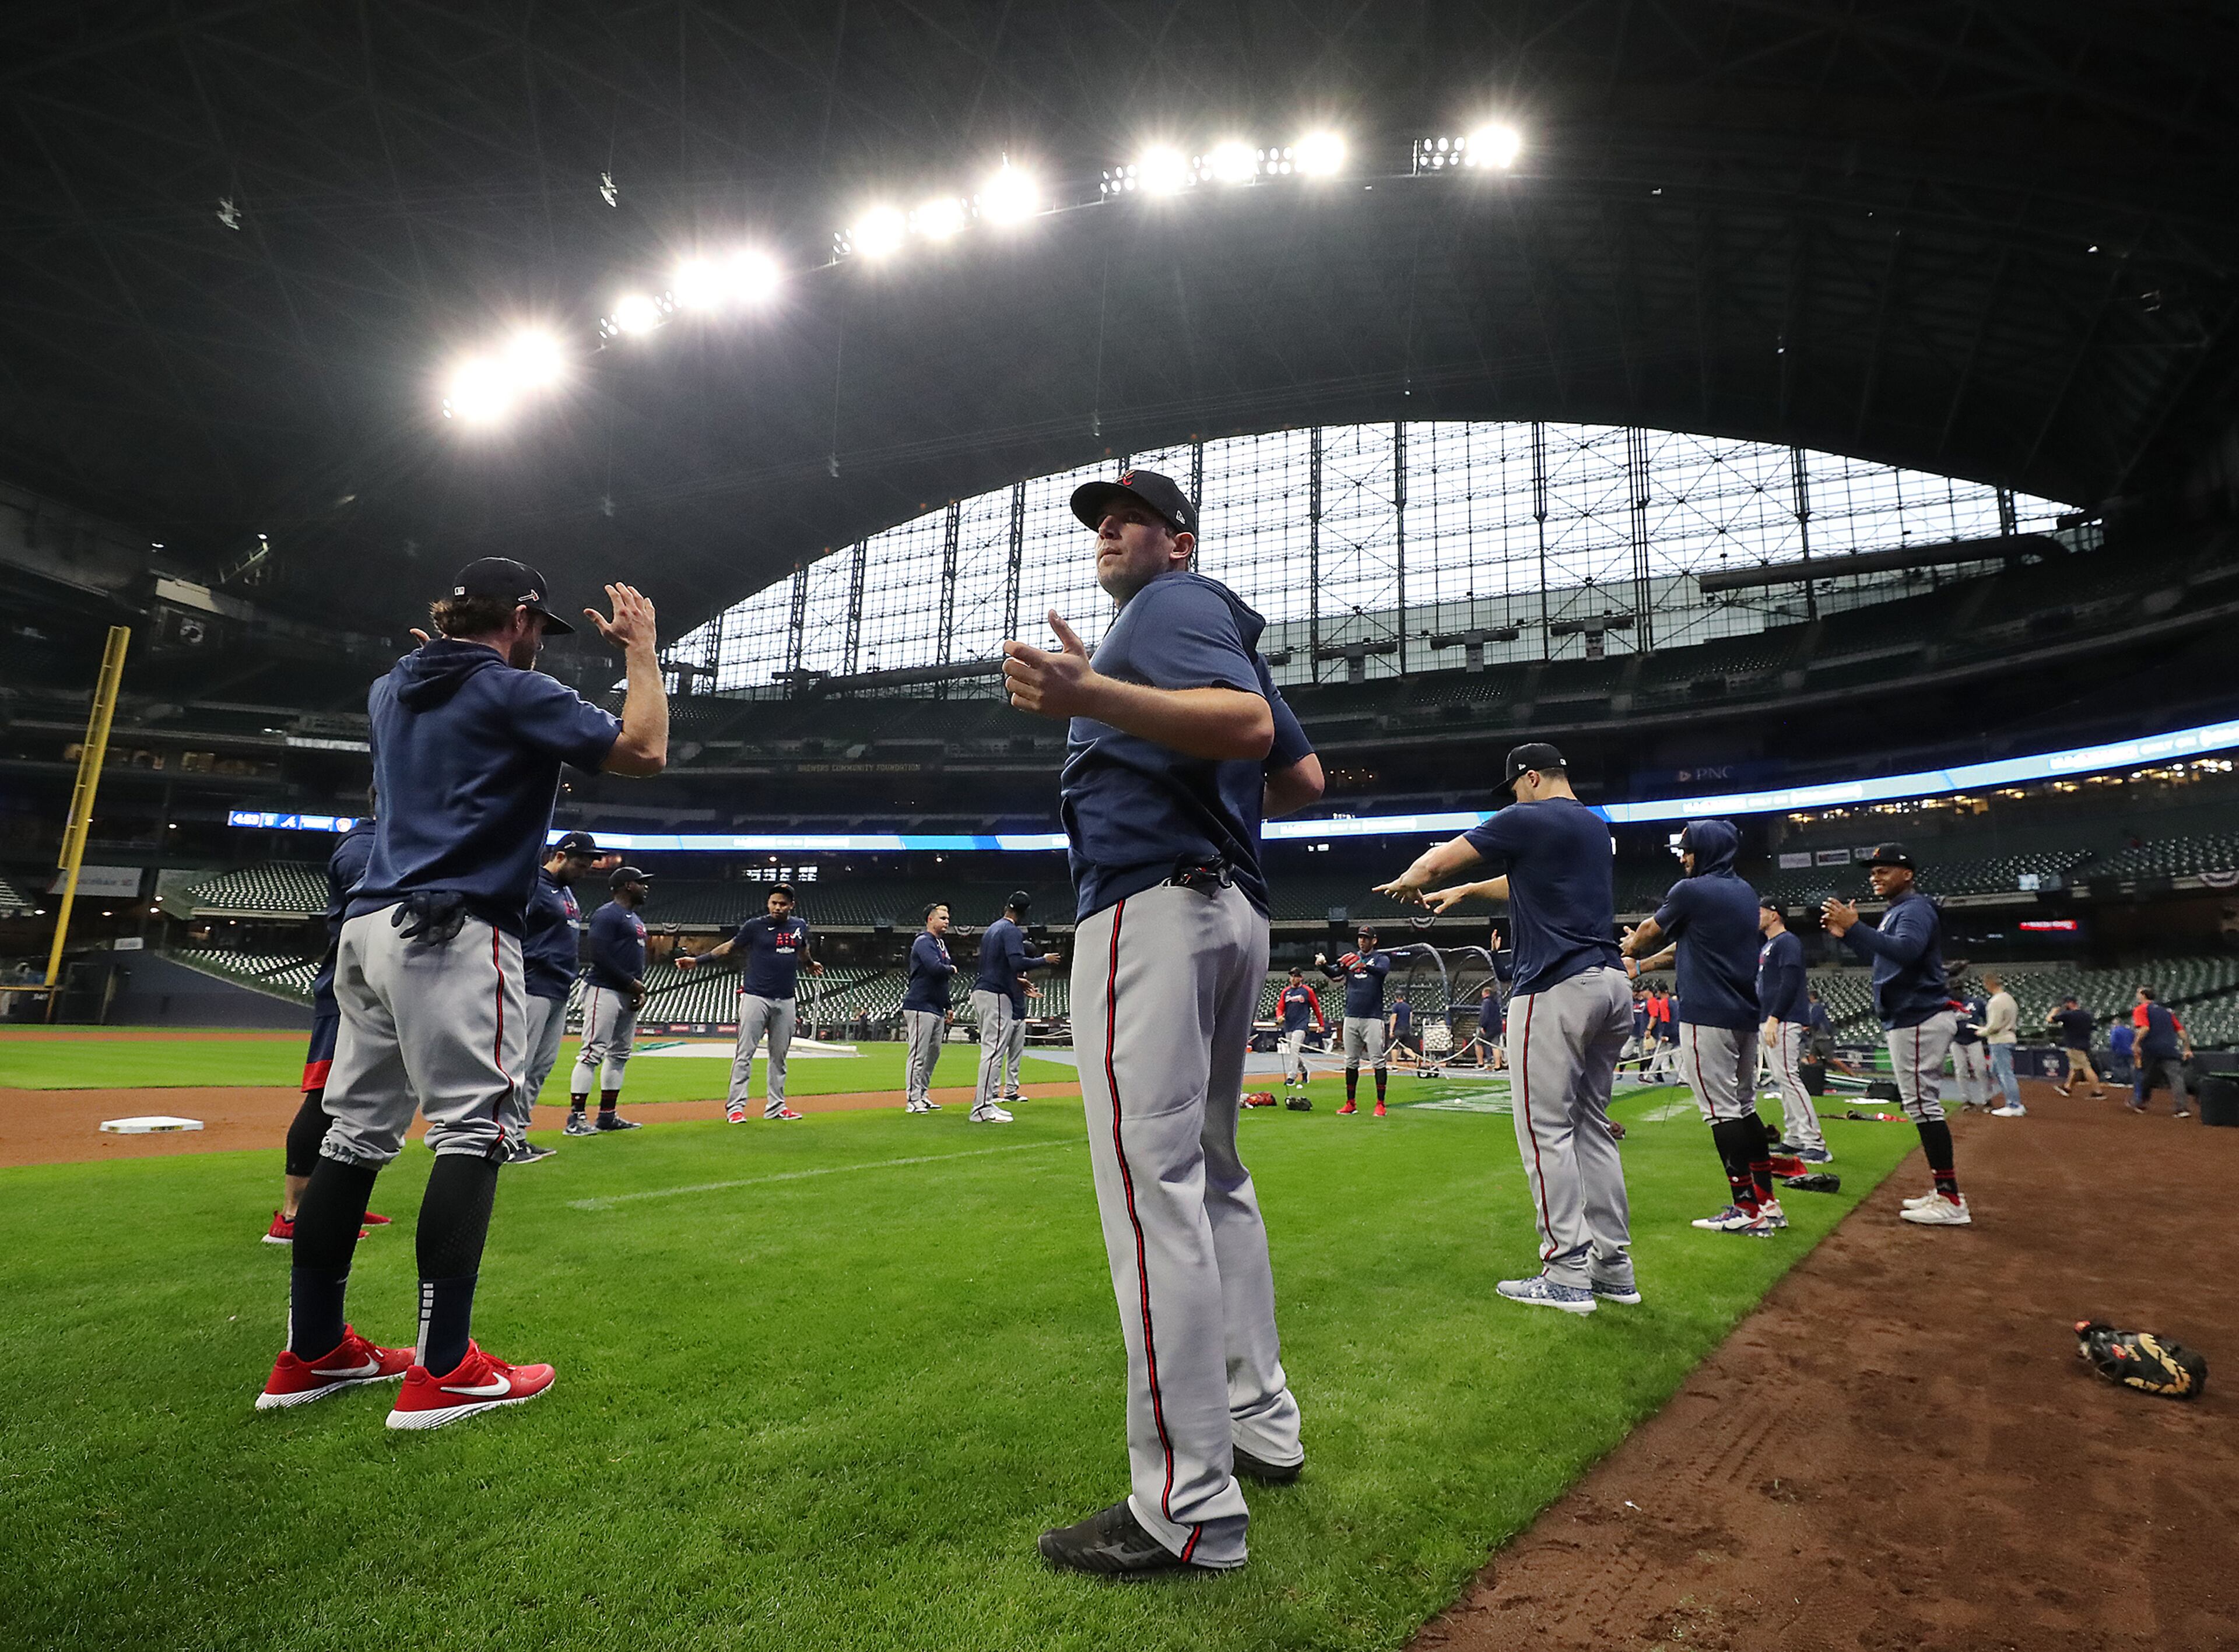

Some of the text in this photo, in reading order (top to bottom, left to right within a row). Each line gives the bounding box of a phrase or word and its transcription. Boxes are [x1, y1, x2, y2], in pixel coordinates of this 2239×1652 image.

[798, 764, 921, 772] BREWERS COMMUNITY FOUNDATION
[1697, 765, 1734, 780] PNC
